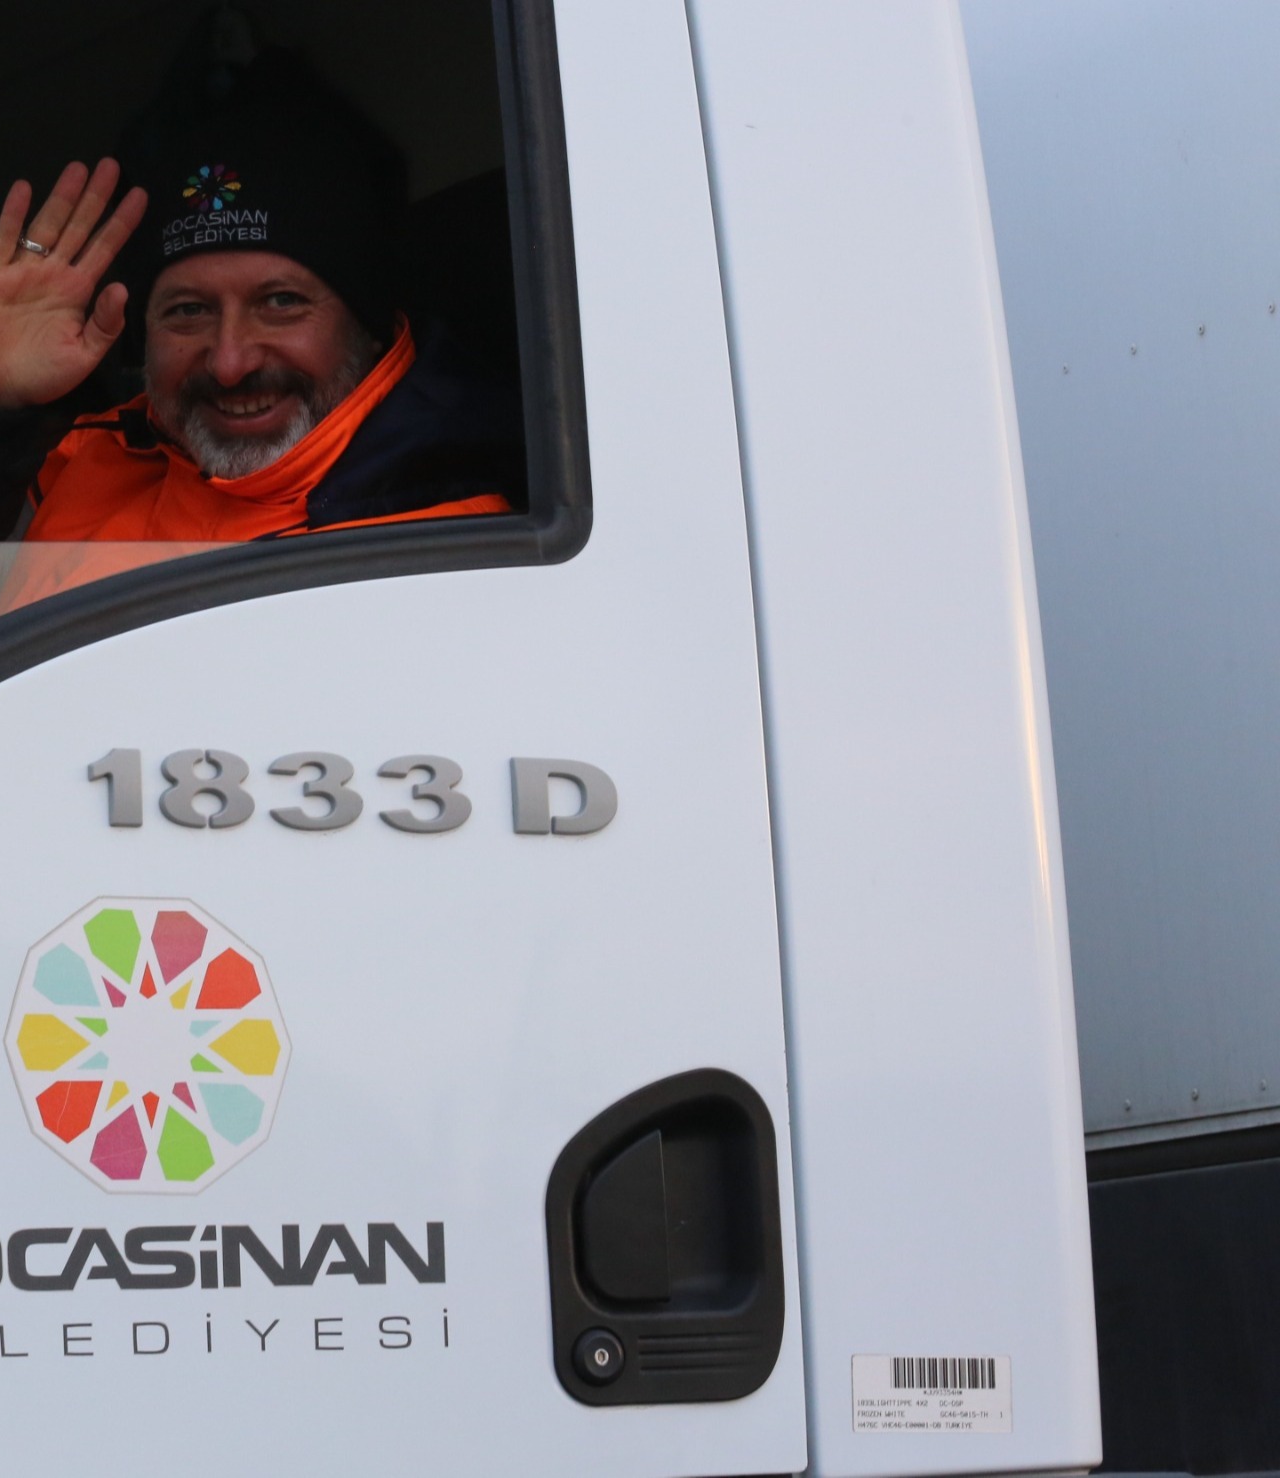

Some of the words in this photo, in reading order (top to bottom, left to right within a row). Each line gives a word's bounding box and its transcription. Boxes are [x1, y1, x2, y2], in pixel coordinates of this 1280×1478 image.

[87, 747, 473, 835] 1833
[509, 756, 619, 836] D
[857, 1410, 882, 1418] FROZEN
[884, 1410, 905, 1418] WHITE
